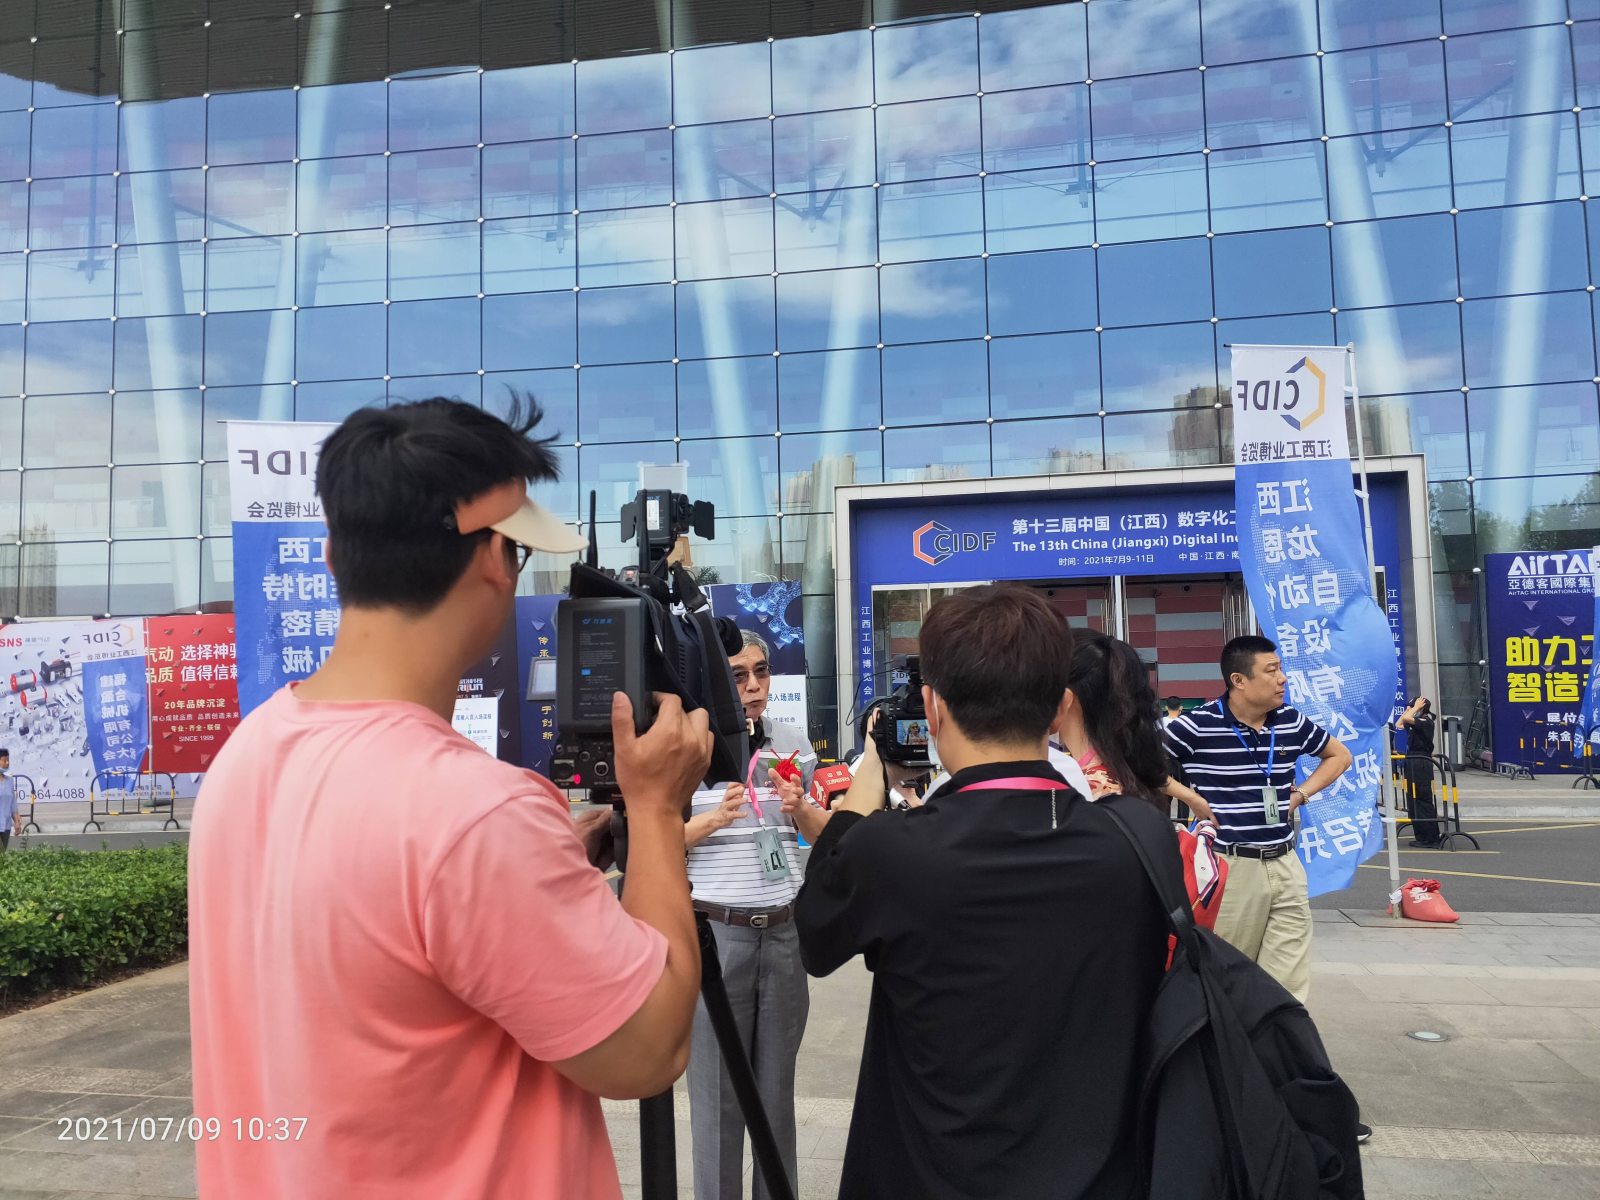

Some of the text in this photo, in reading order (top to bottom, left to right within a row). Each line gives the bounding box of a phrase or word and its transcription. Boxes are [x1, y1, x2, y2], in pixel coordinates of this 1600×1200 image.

[934, 532, 997, 553] CIDF
[1012, 541, 1036, 552] The
[1039, 539, 1068, 551] 13th
[1071, 538, 1108, 550] China
[1111, 535, 1169, 549] (Jiangxi)
[1172, 533, 1218, 548] Digital
[1508, 577, 1595, 590] 亞德客國際集
[861, 606, 873, 704] 江西工业博览会
[1507, 671, 1589, 703] 智造
[15, 788, 86, 801] 0-64-4088
